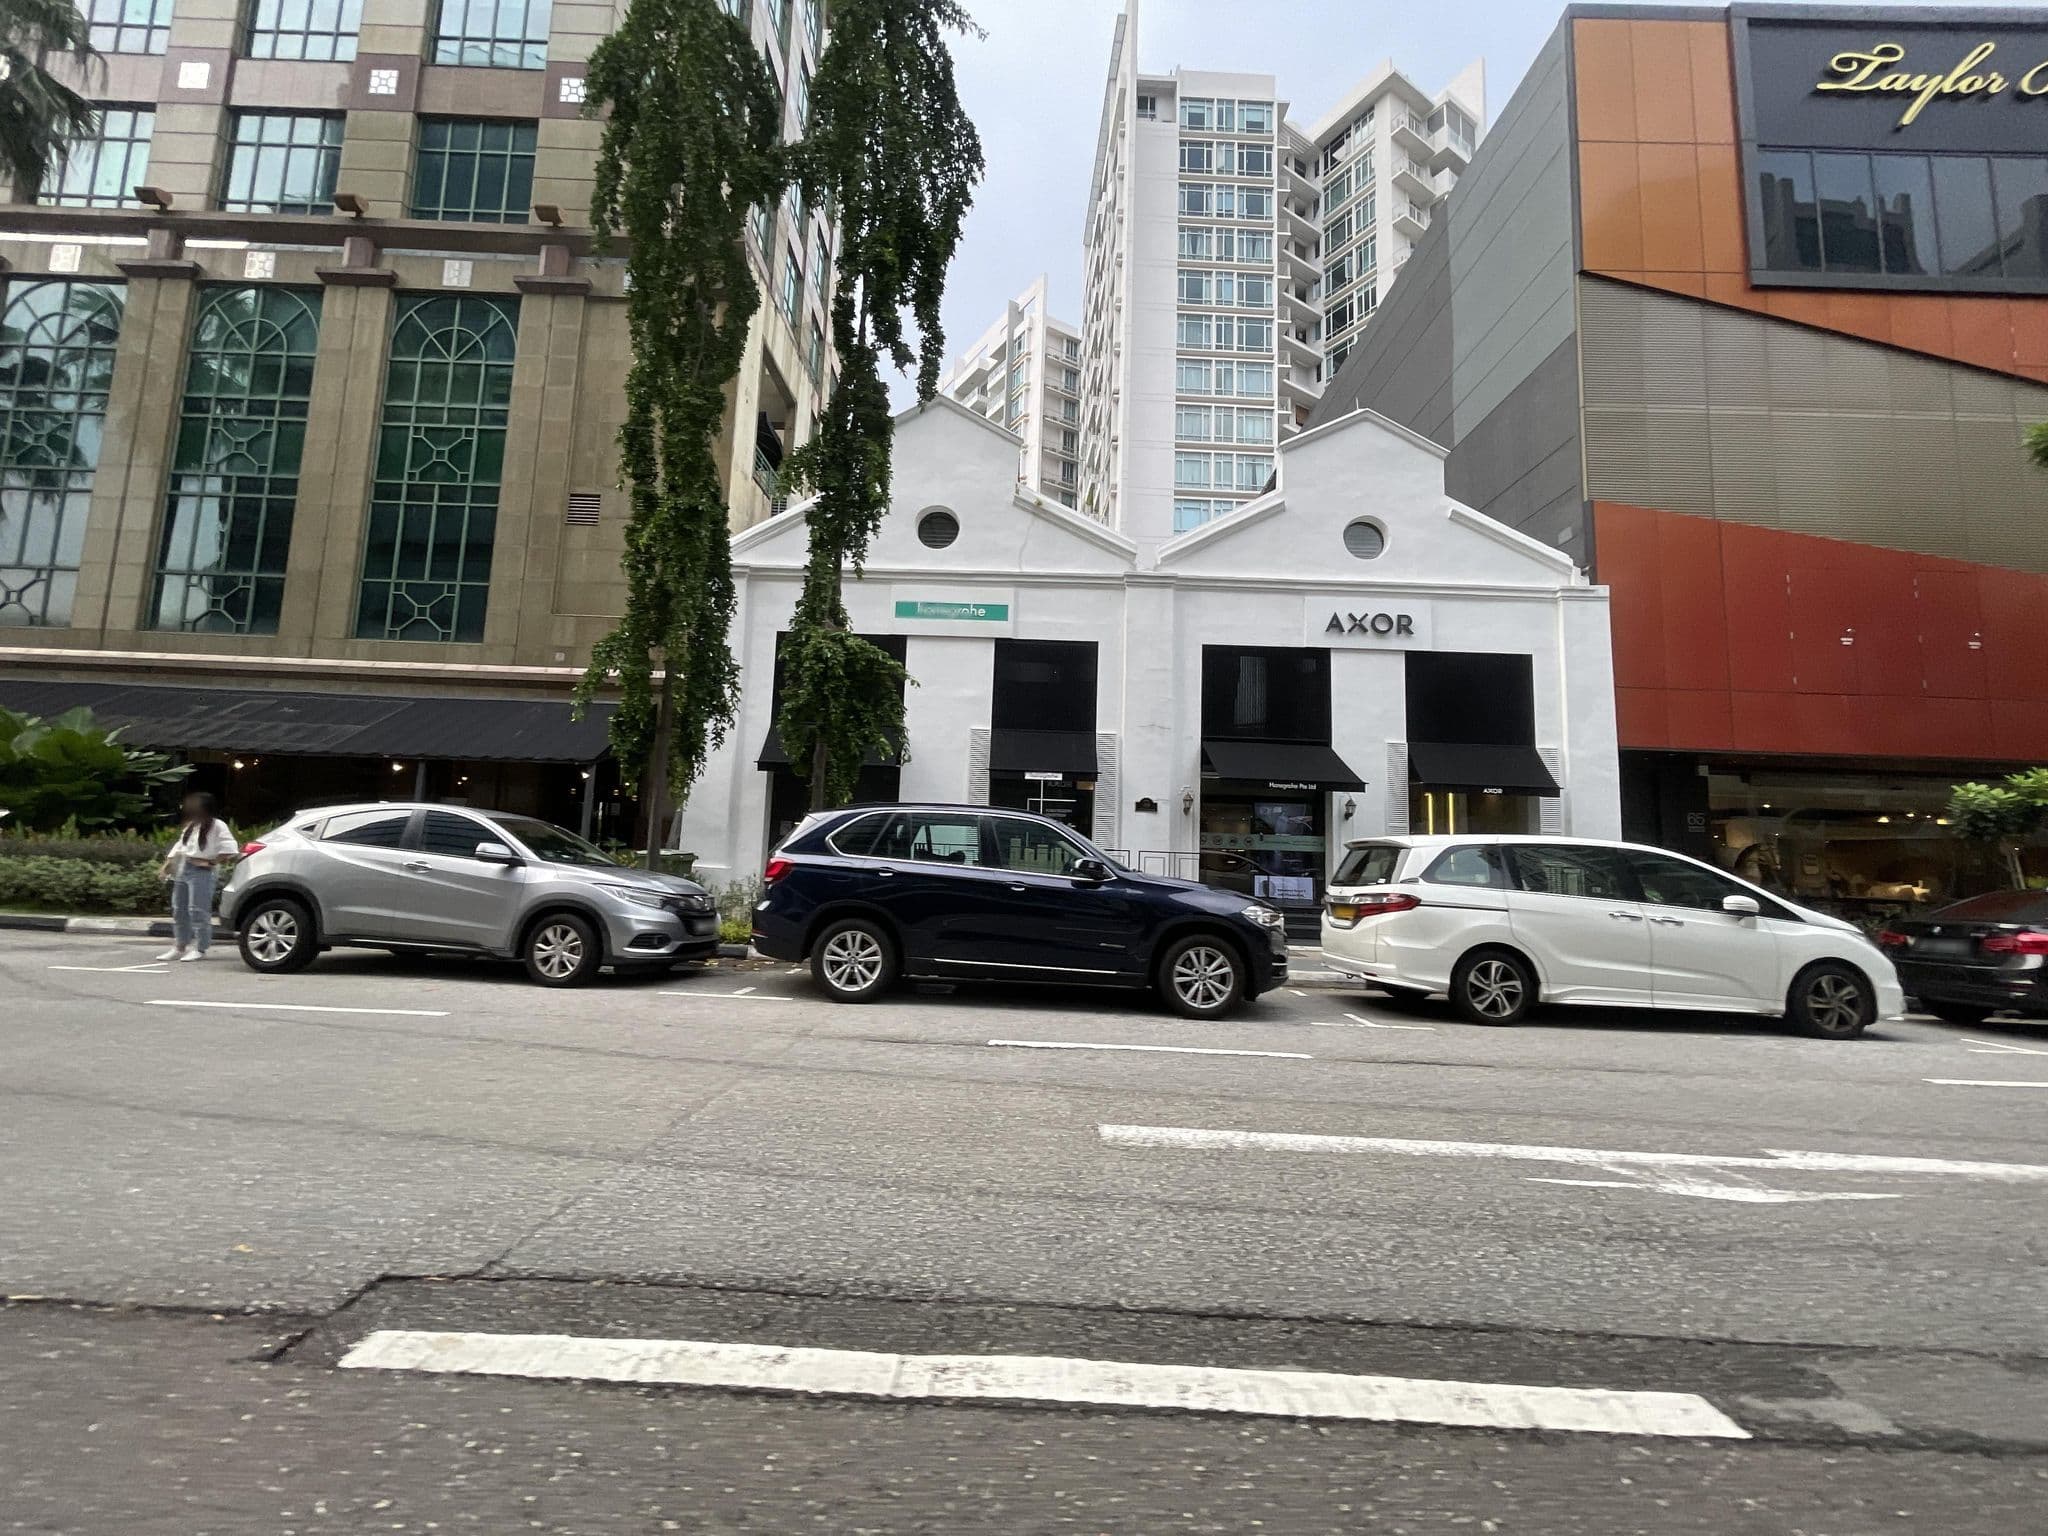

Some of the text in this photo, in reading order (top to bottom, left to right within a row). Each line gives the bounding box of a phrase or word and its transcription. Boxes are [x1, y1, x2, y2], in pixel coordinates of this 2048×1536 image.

[1816, 42, 2010, 126] Taylor
[917, 601, 986, 618] hrohe
[1325, 612, 1414, 635] AXOR
[1686, 812, 1706, 825] 65
